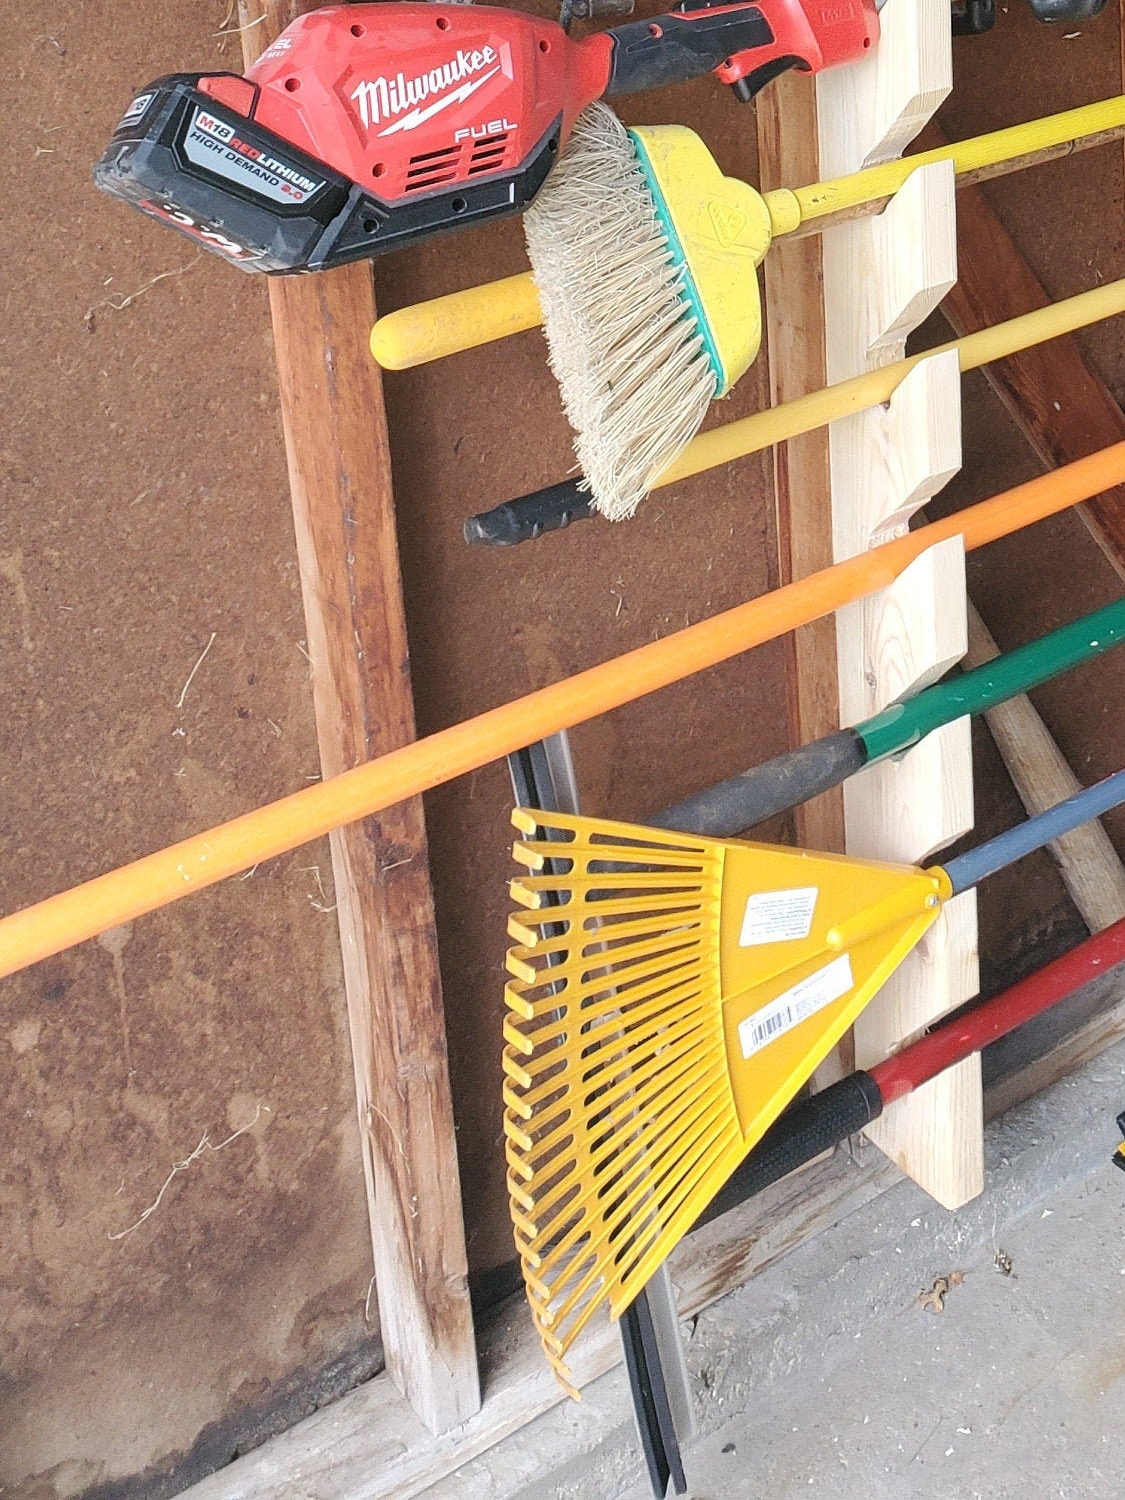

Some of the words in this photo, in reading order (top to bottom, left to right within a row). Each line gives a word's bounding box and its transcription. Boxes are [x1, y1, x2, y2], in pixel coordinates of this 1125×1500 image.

[350, 45, 497, 130] Milwaukee
[200, 115, 231, 139] M18
[454, 118, 518, 143] FUEL
[190, 131, 224, 154] HIGH
[225, 151, 280, 187] DEMAND
